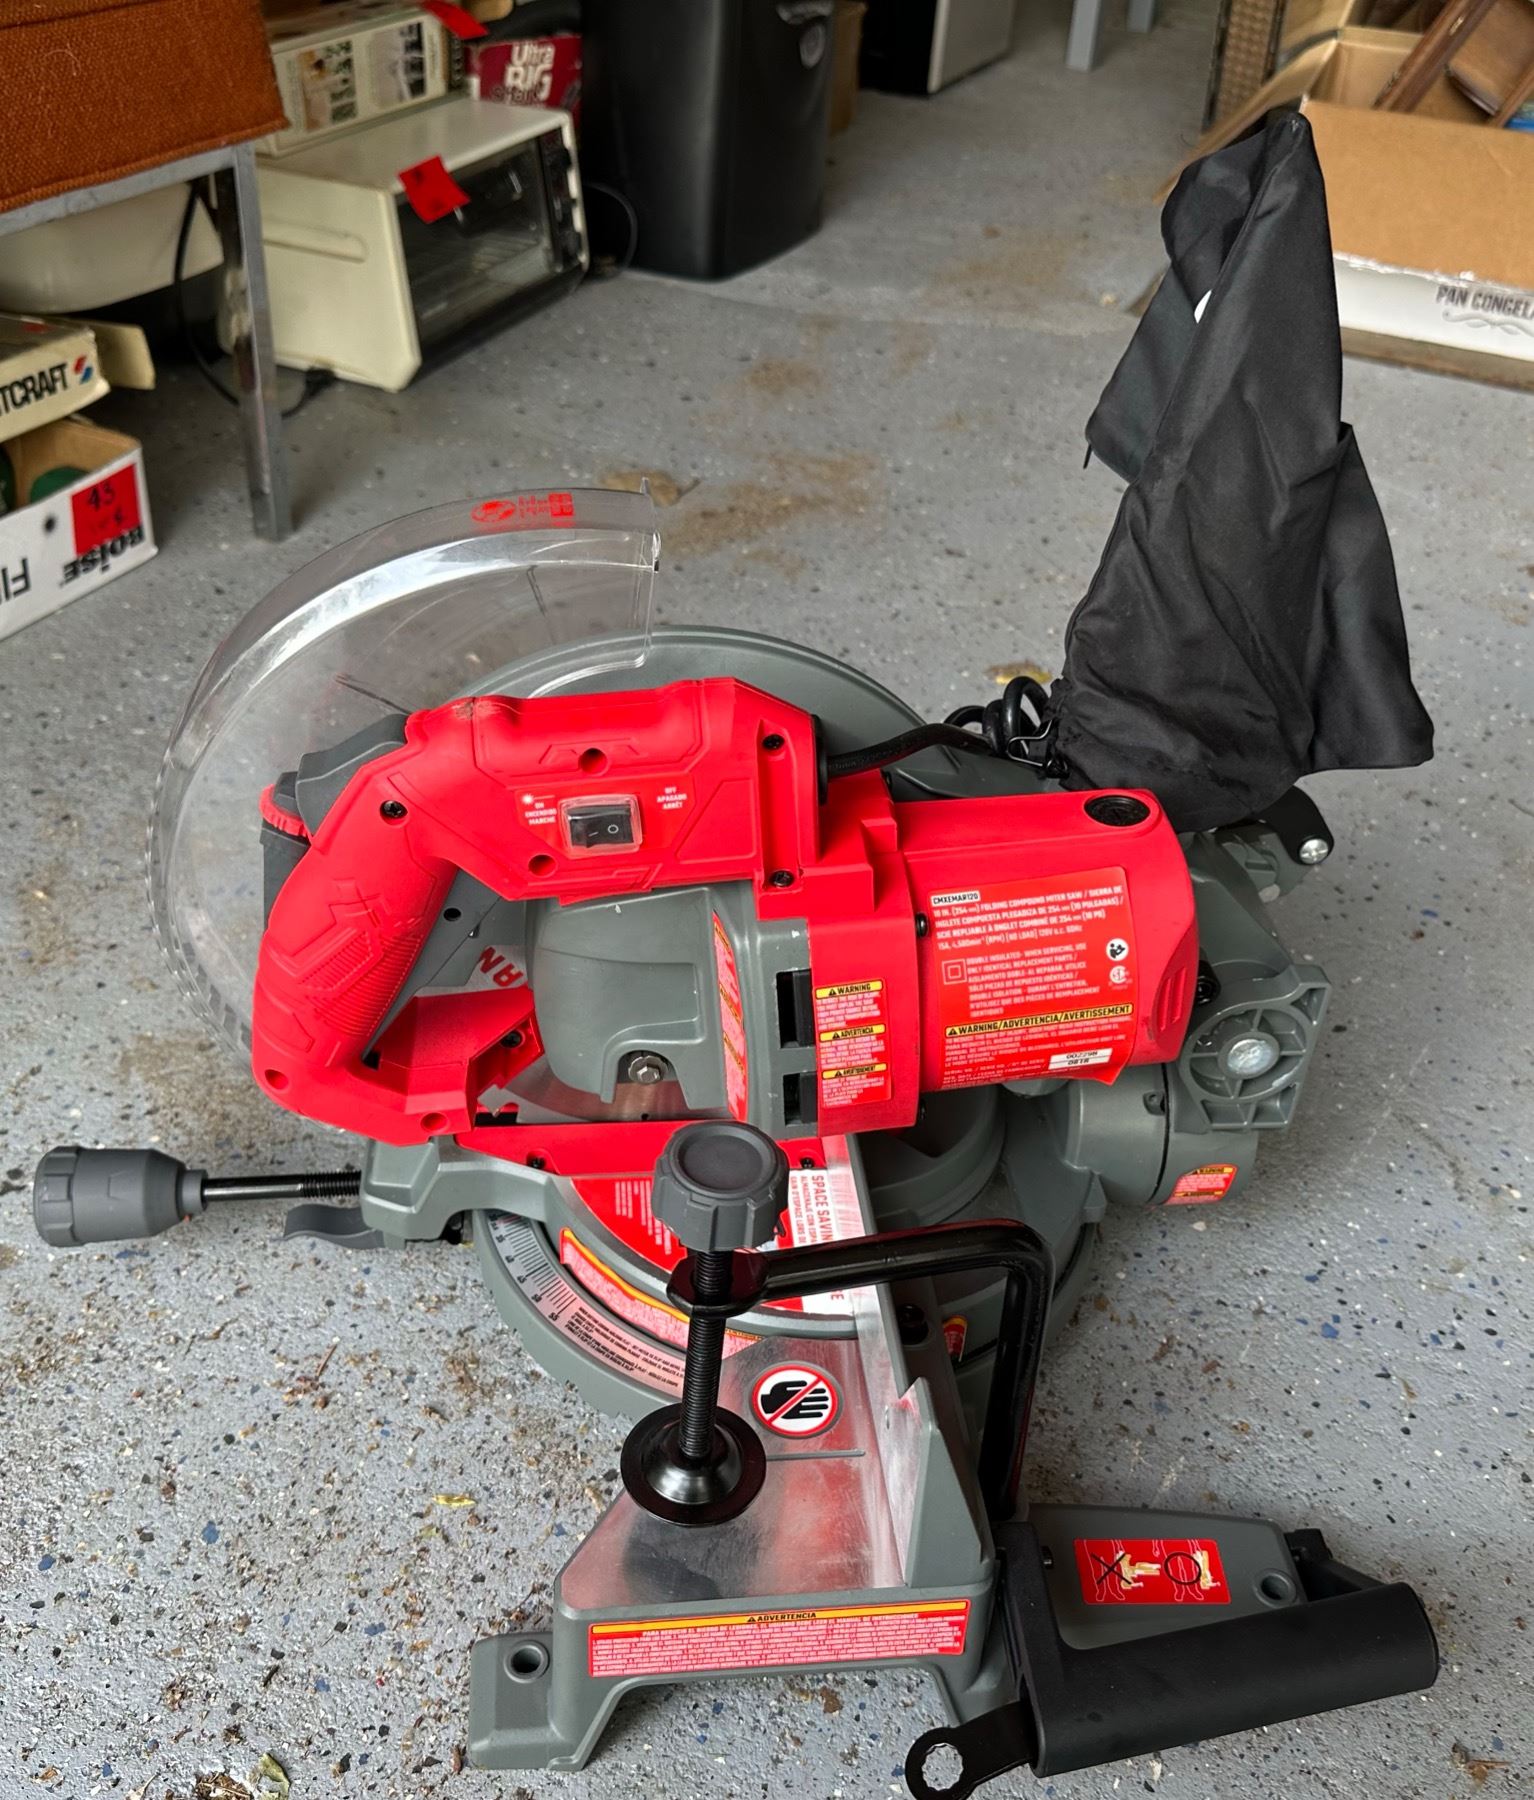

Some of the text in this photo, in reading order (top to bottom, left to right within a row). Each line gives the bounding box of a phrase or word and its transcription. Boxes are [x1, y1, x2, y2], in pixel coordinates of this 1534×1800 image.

[1436, 284, 1468, 308] PAN
[0, 362, 69, 416] TCRAFT
[657, 794, 687, 803] APAGADO
[525, 808, 557, 818] ENCENDIDO
[837, 983, 871, 994] WARNING
[841, 1027, 874, 1038] ADVERTENCIA
[812, 1176, 829, 1208] SPACE
[757, 1612, 816, 1622] ADVERTENCIA
